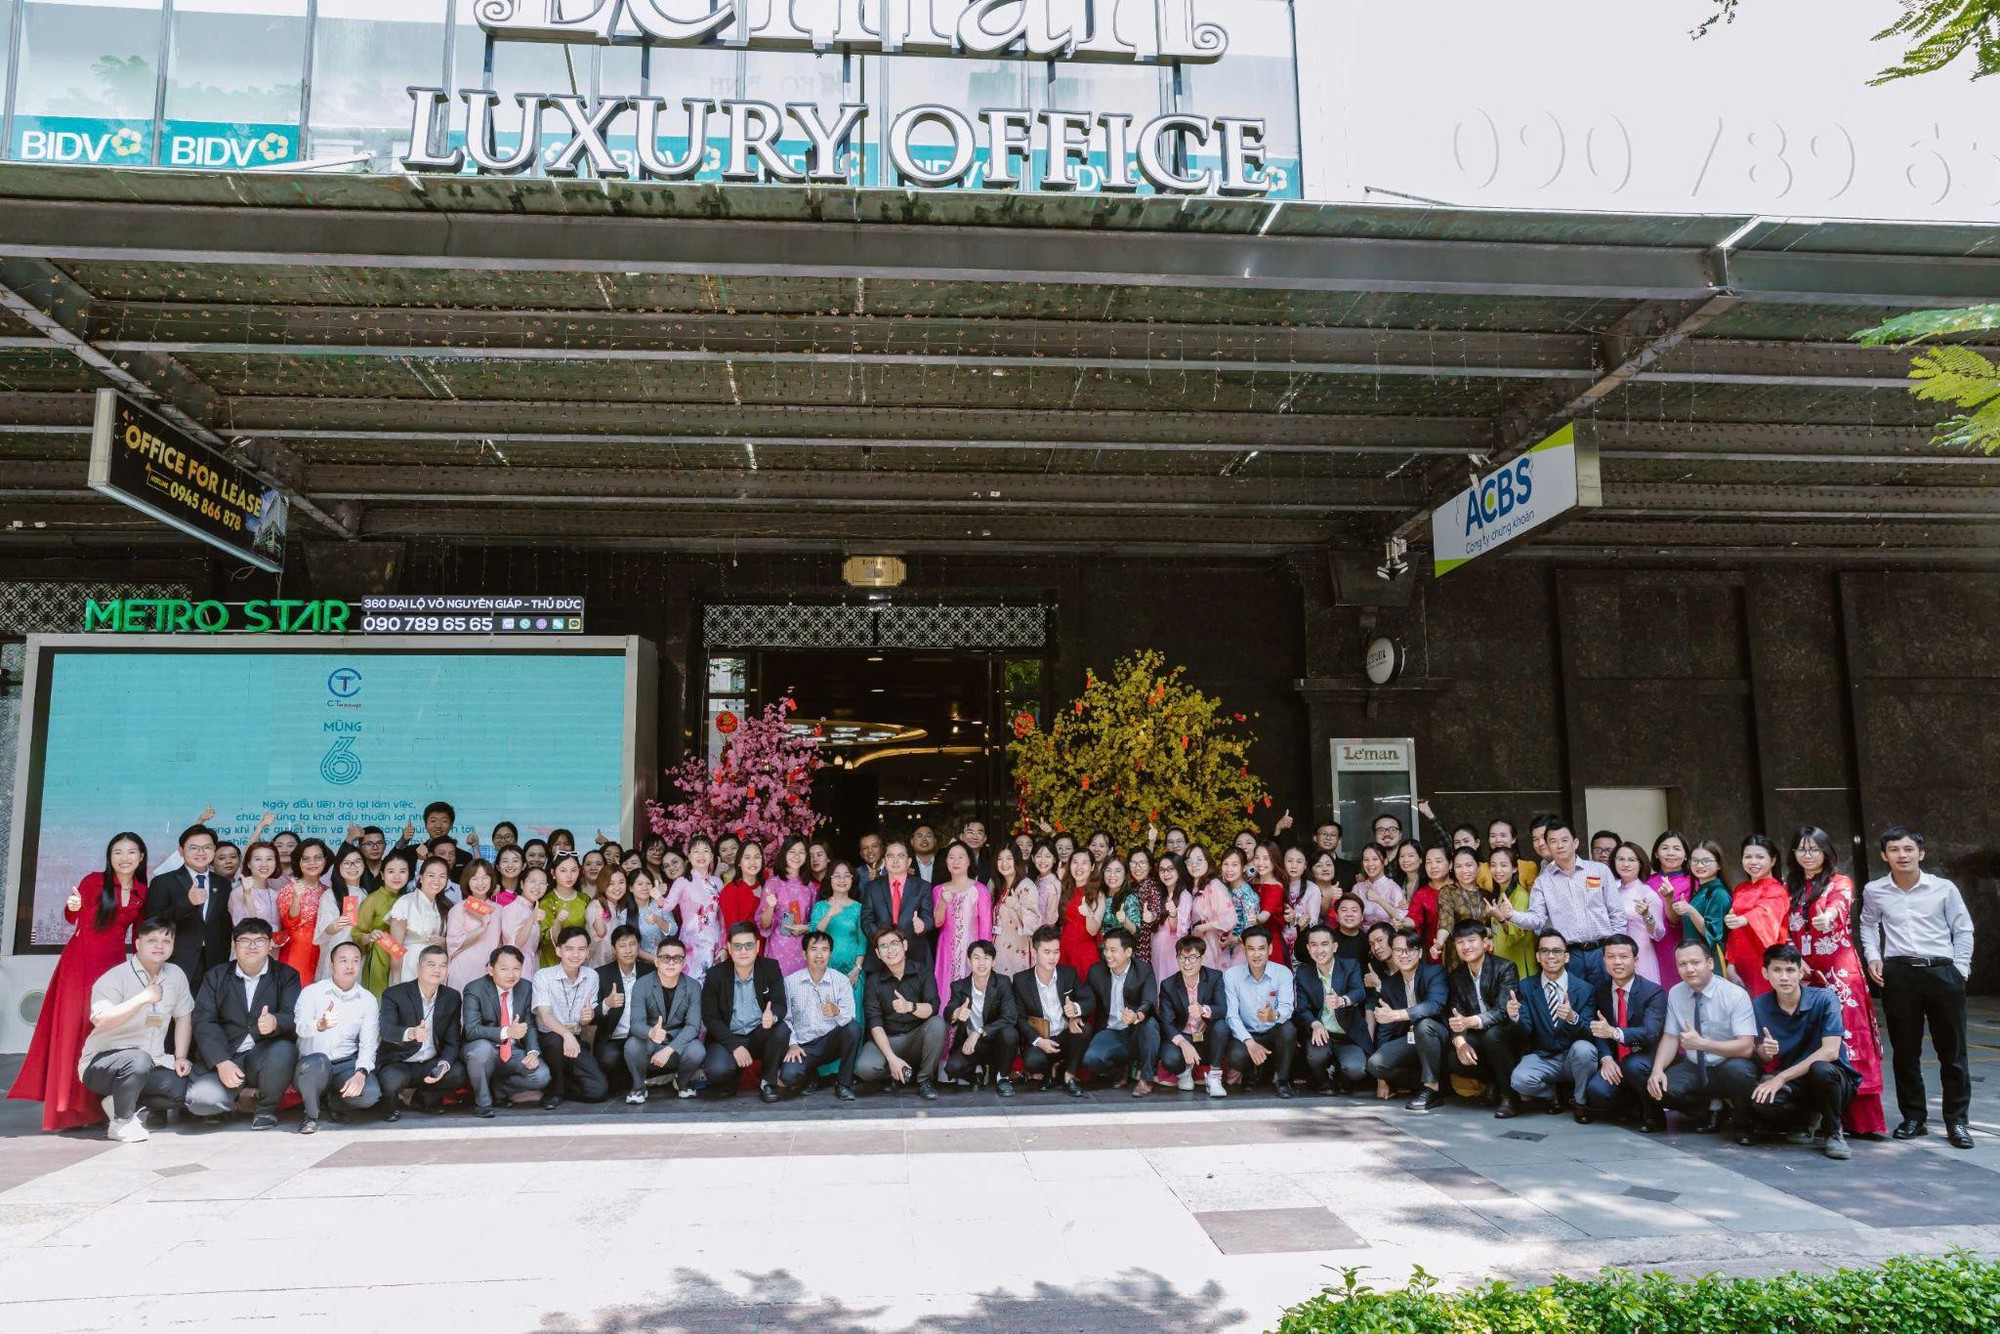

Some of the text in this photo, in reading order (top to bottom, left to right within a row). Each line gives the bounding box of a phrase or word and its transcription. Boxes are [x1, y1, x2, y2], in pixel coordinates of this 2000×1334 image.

[21, 131, 112, 162] BIDV
[171, 136, 259, 166] BIDV
[400, 86, 1273, 196] LUXURY OFFICE
[125, 424, 264, 518] OFFICE FOR LEASE
[169, 481, 200, 510] 0945
[200, 497, 221, 520] 866
[222, 508, 242, 531] 878
[1465, 457, 1532, 537] ACBS
[85, 599, 350, 633] METRO STAR
[363, 617, 493, 631] 090 789 65 65
[364, 599, 387, 608] 360
[388, 599, 408, 610] ĐẠI
[410, 597, 426, 610] LỘ
[427, 597, 445, 608] VÕ
[447, 597, 493, 609] NGUYÊN
[495, 597, 522, 609] GIÁP
[531, 597, 554, 609] THỦ
[556, 597, 581, 609] ĐỨC
[320, 736, 362, 786] 6
